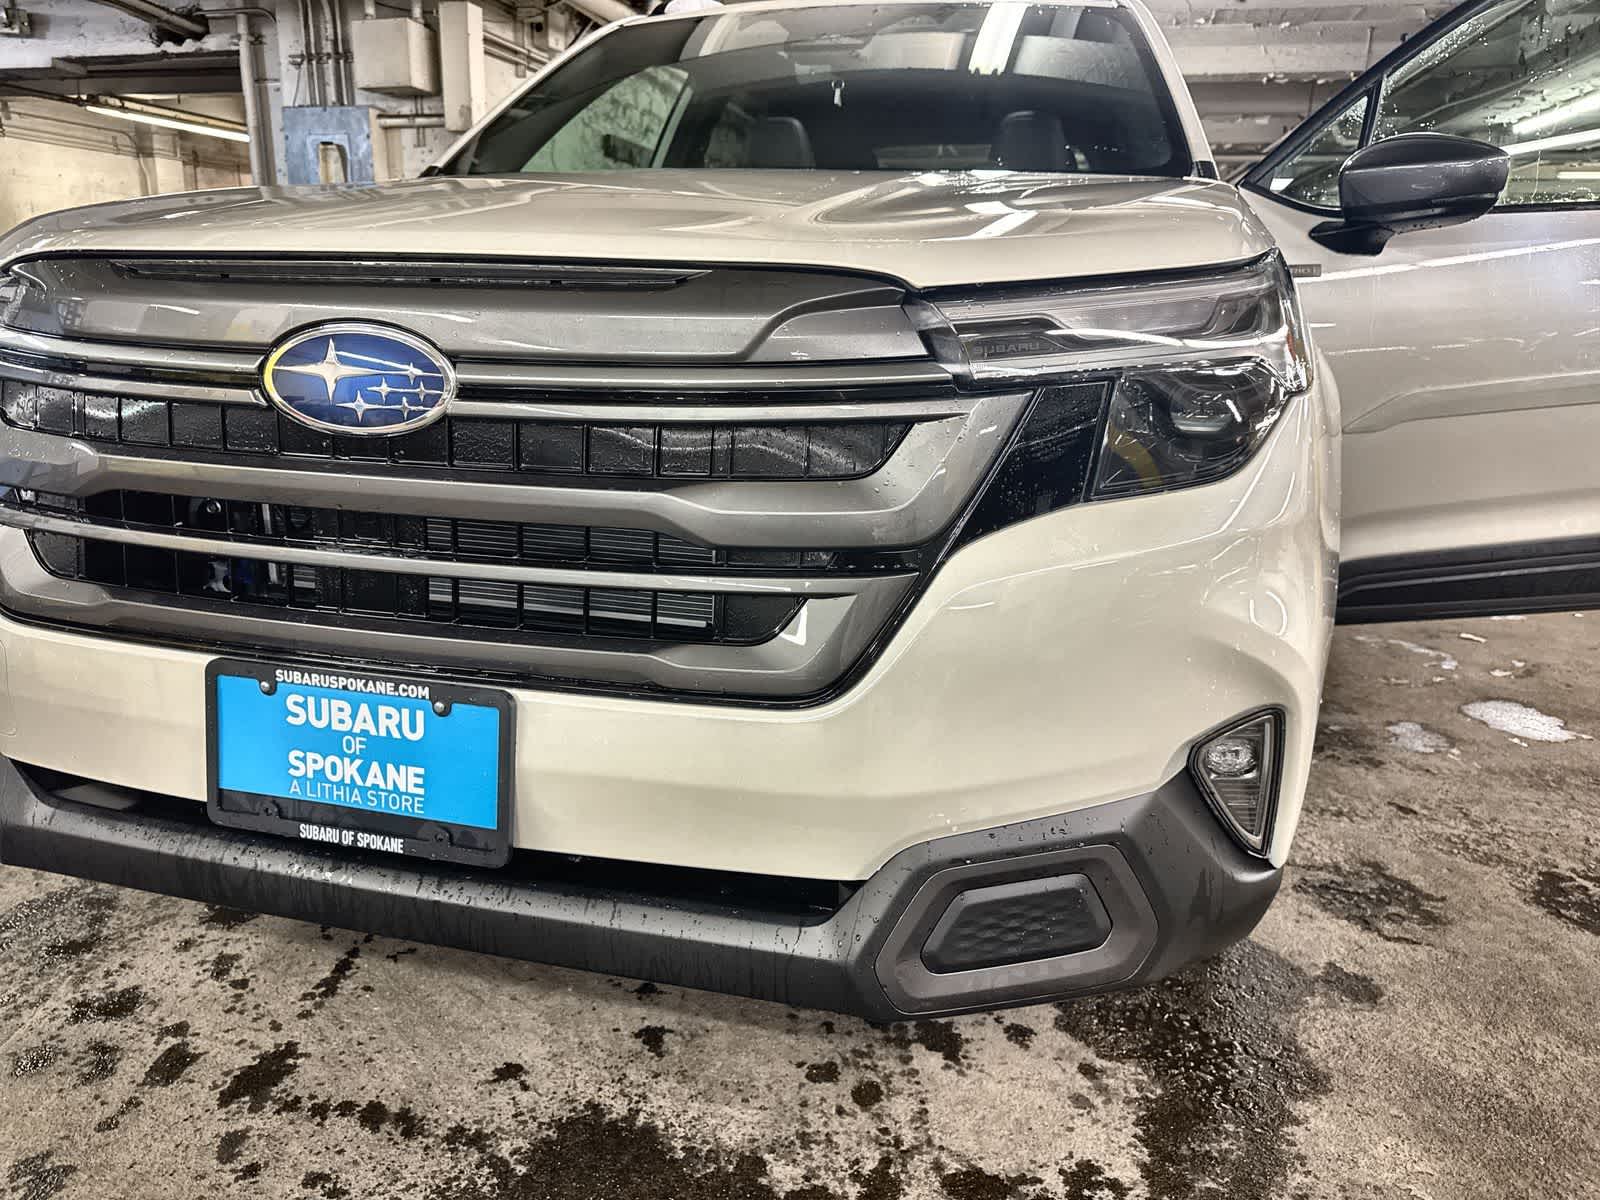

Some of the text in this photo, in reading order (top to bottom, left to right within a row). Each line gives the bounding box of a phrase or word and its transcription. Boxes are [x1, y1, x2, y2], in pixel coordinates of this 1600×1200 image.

[973, 341, 1040, 354] SUBARU
[275, 669, 430, 699] SUBARUSPOKANE.COM
[286, 694, 425, 741] SUBARU
[342, 735, 366, 755] OF
[287, 750, 425, 795] SPOKANE
[290, 781, 425, 814] A LITHIA STORE
[299, 823, 404, 853] SUBARU OF SPOKANE
